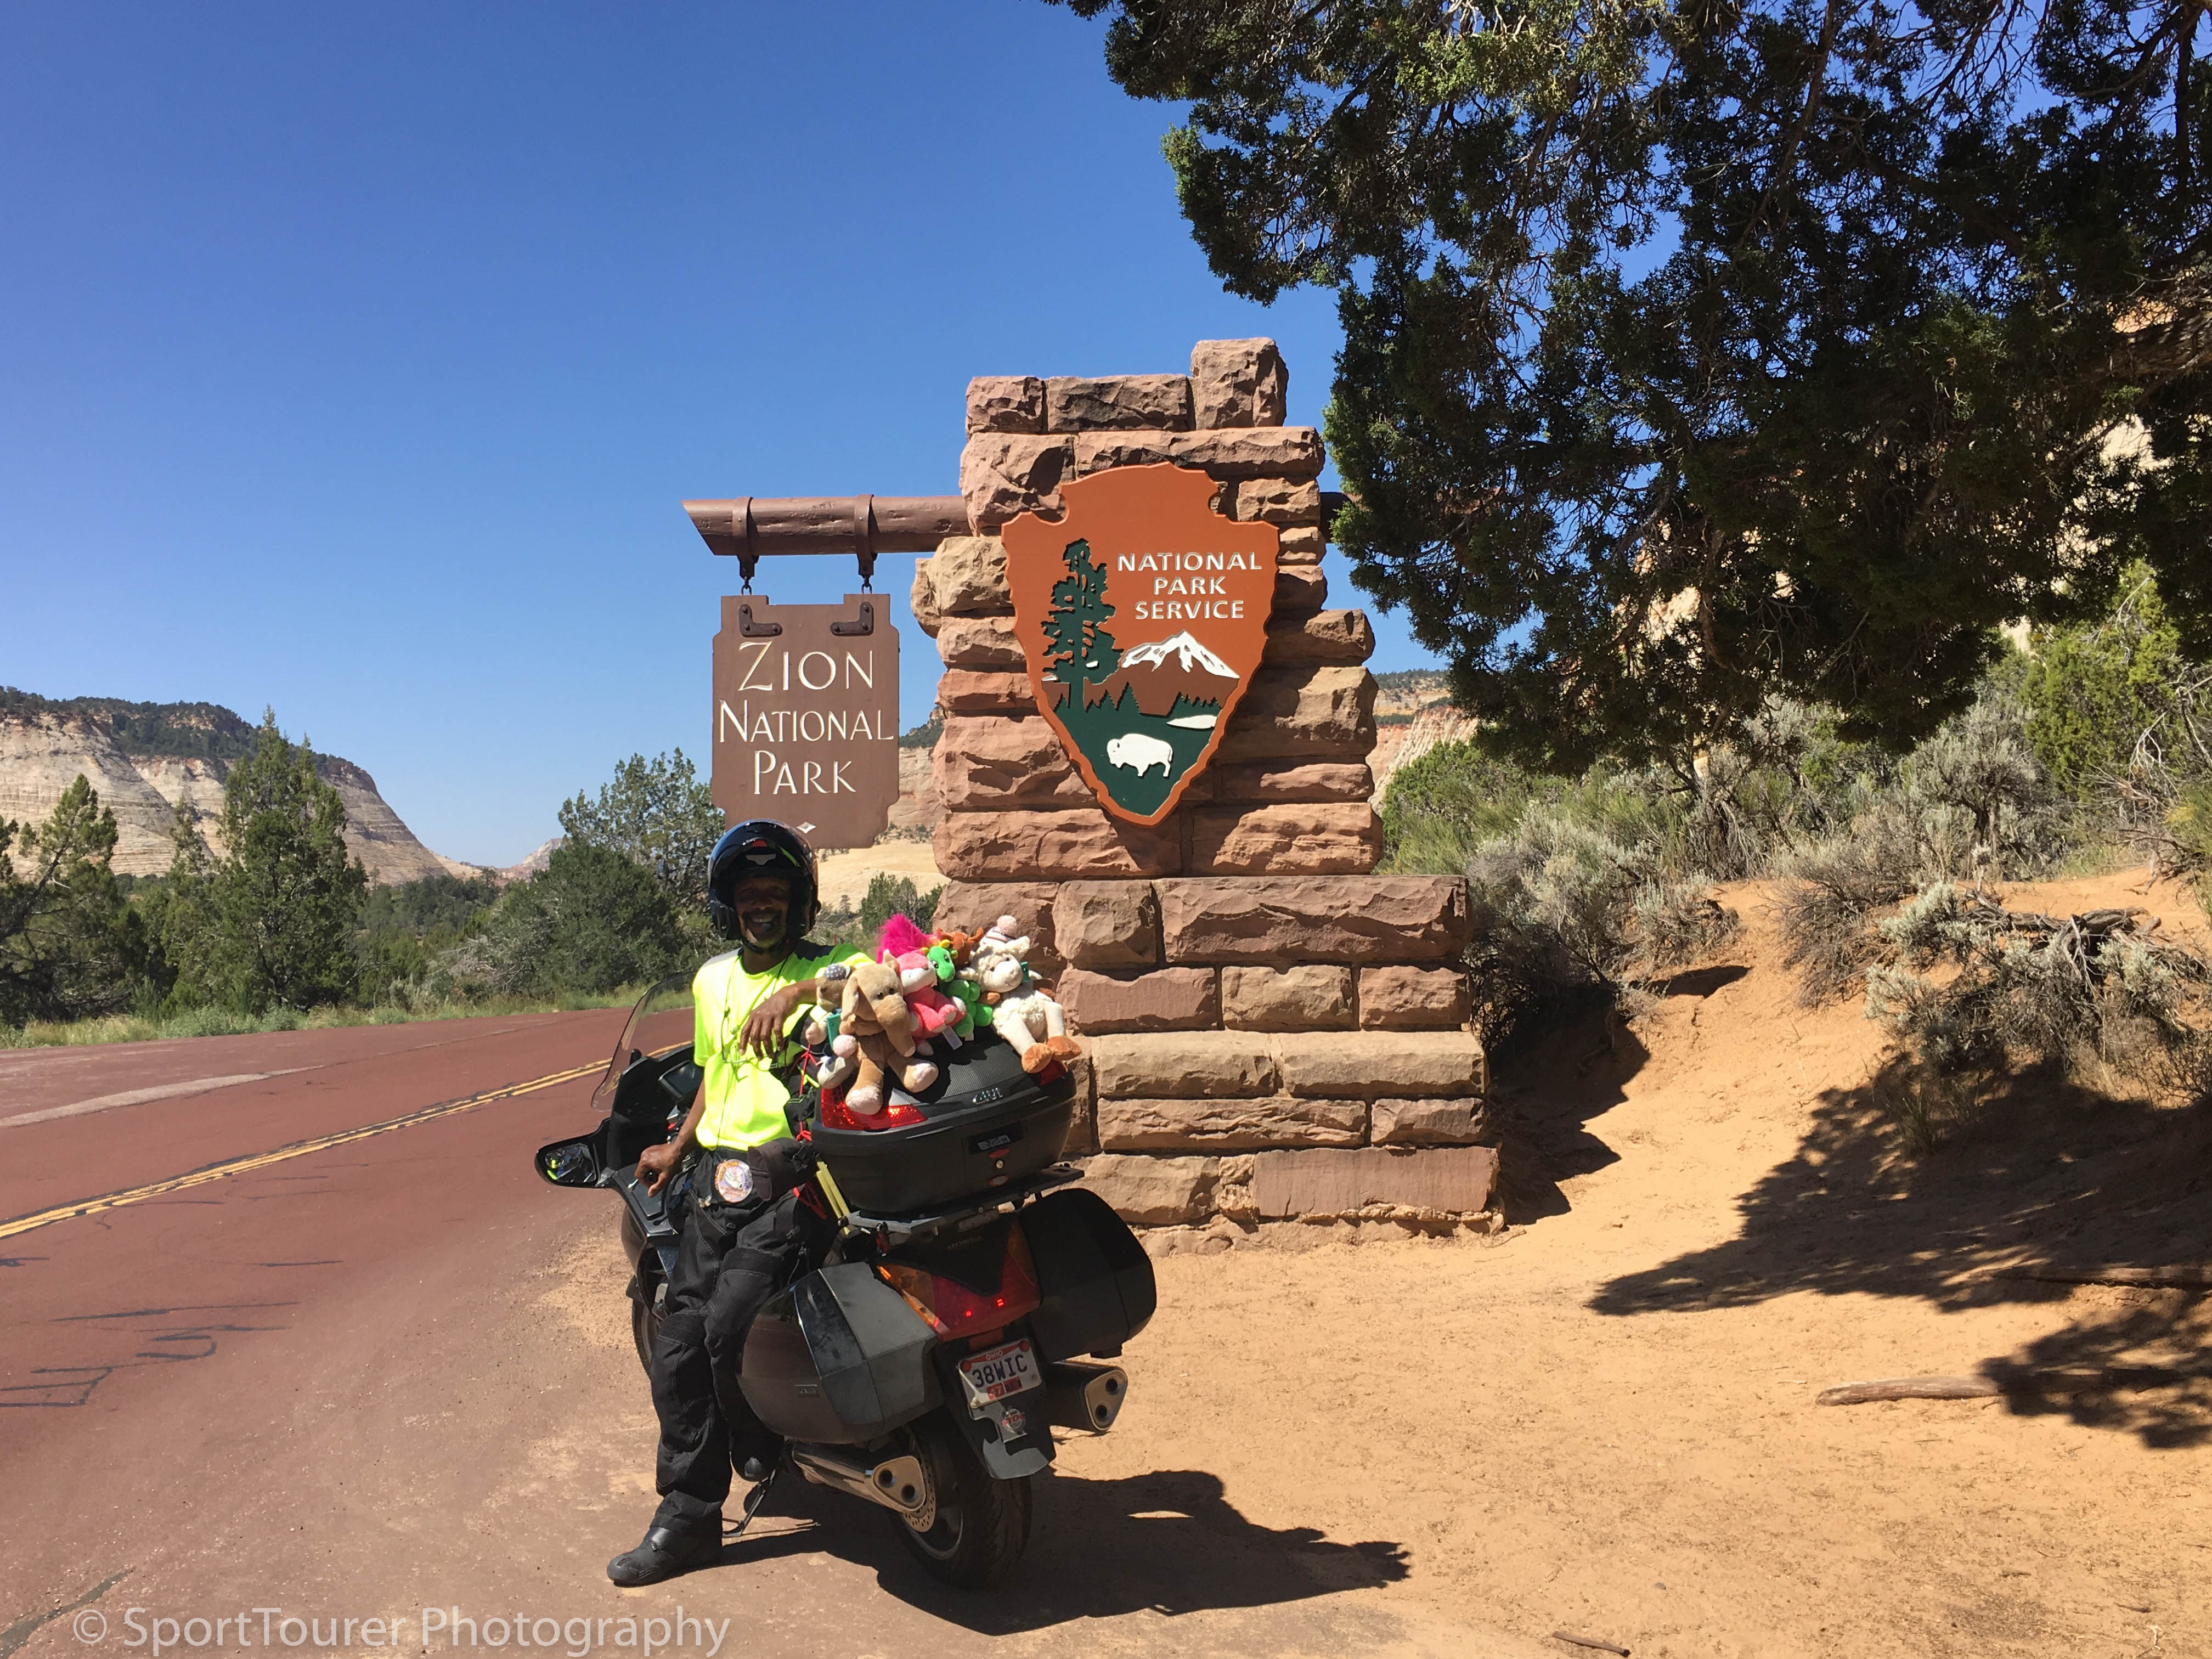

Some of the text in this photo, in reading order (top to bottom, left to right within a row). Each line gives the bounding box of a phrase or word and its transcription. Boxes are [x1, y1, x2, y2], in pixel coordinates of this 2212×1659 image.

[1117, 551, 1262, 571] NATIONAL
[1154, 576, 1227, 595] PARK
[1135, 600, 1244, 619] SERVICE
[738, 641, 873, 691] ZION
[719, 699, 894, 743] NATIONAL
[754, 750, 856, 794] PARK
[985, 1350, 1003, 1361] OHIO
[972, 1354, 1028, 1387] 38WIC
